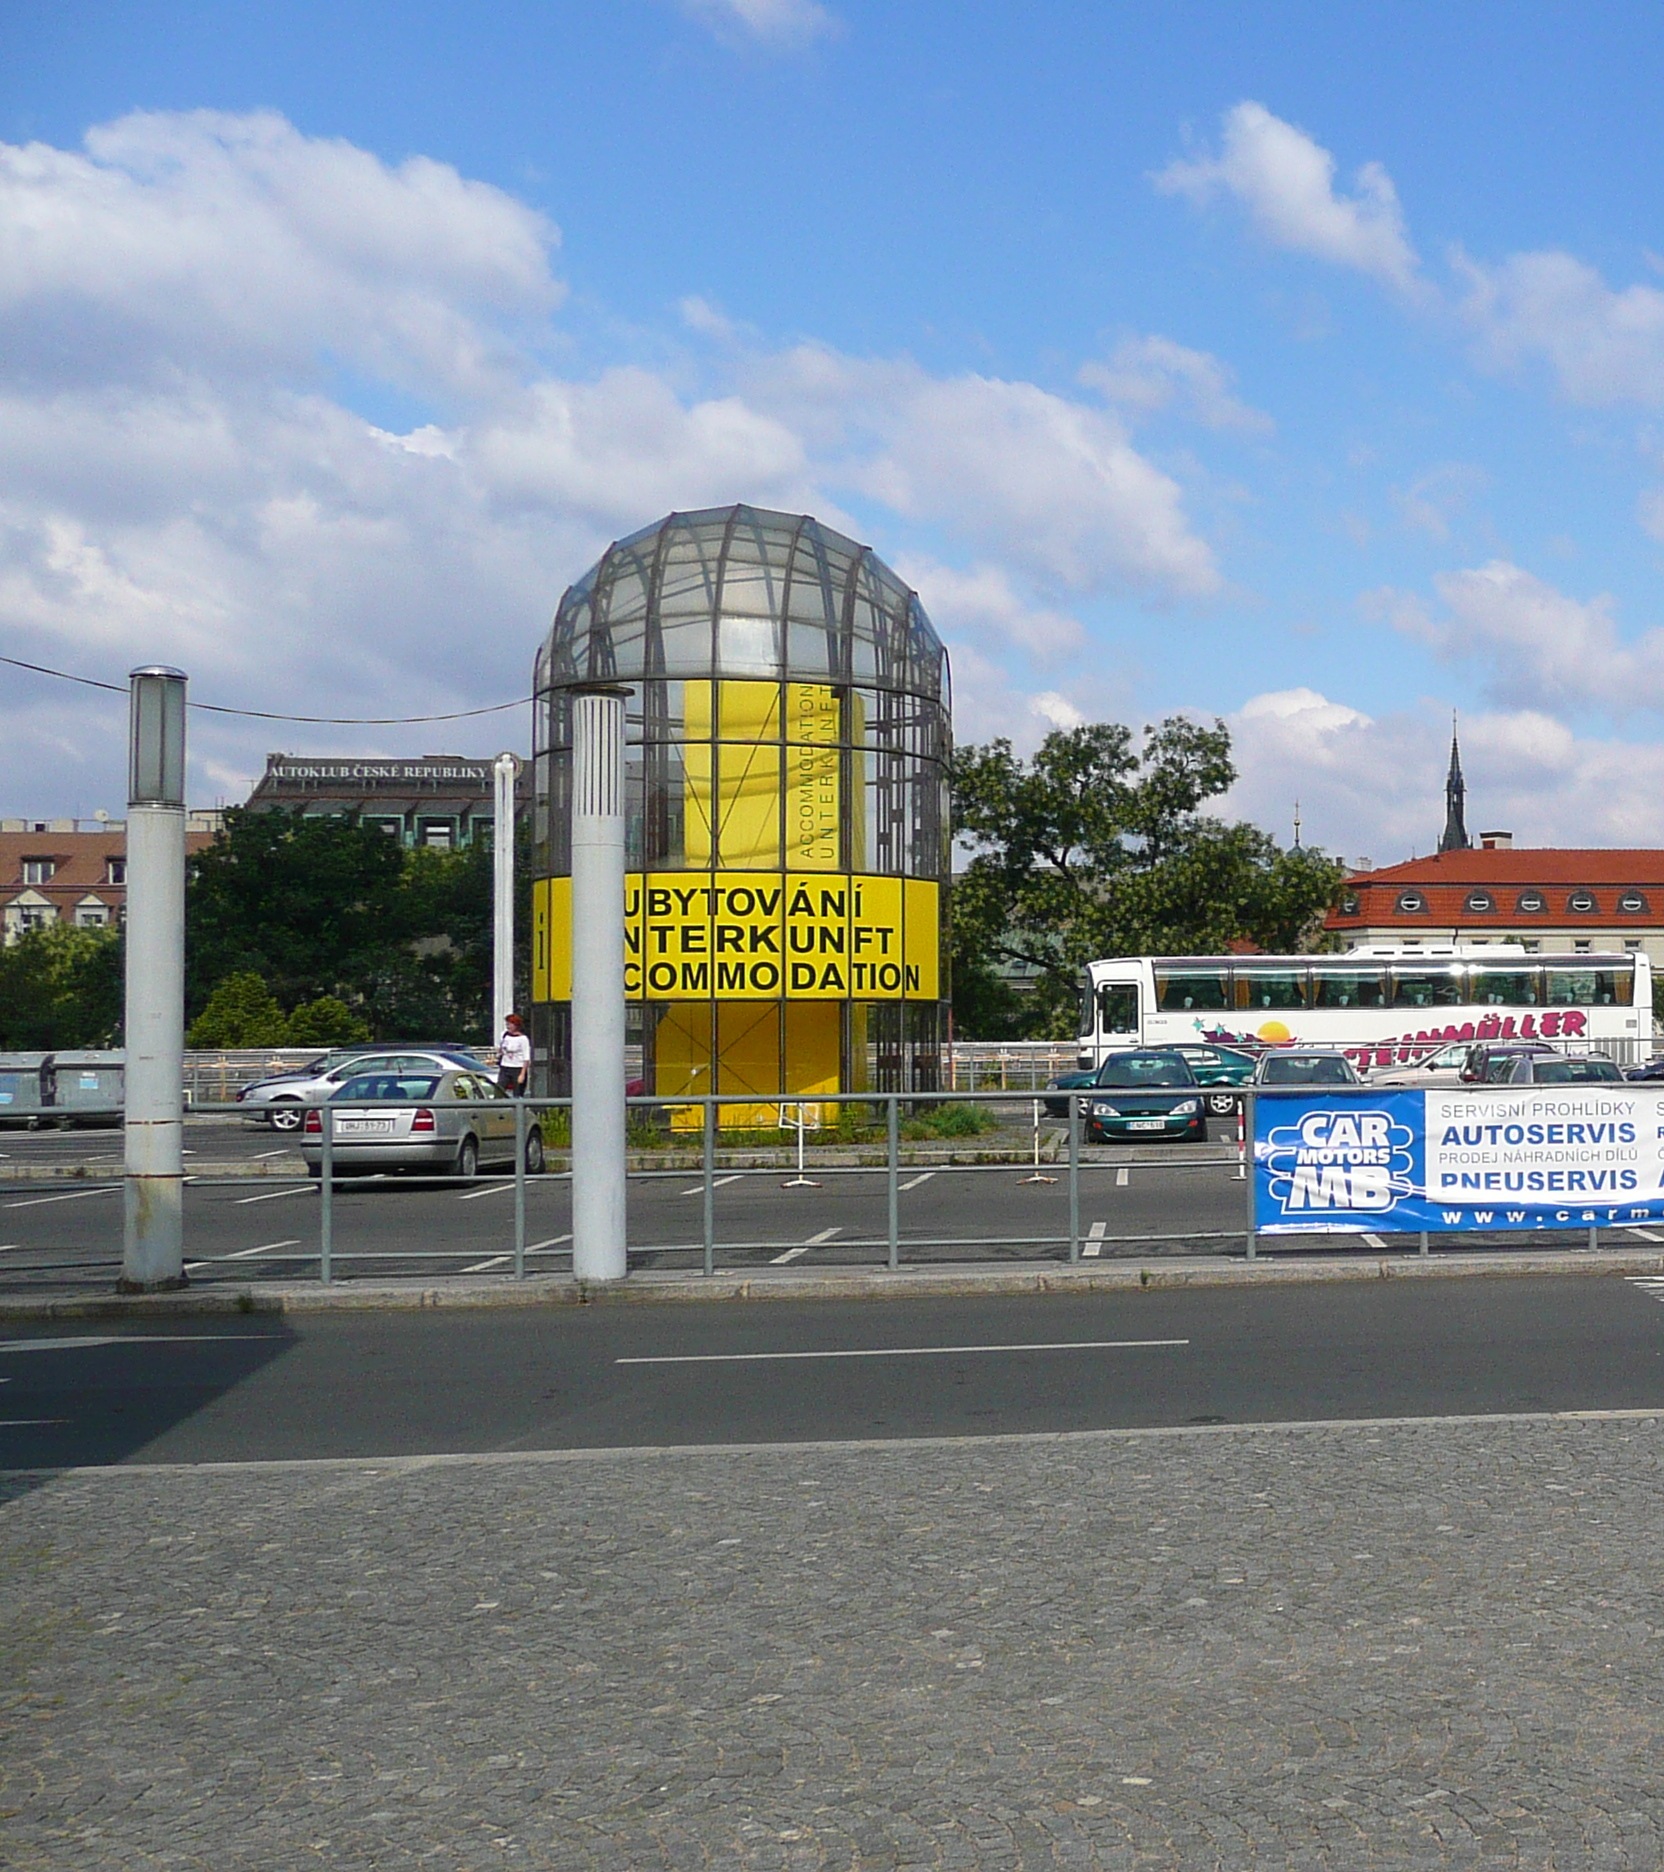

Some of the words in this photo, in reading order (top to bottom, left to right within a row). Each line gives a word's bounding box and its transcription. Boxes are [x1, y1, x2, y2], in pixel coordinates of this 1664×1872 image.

[268, 766, 350, 778] AUTOKLUB
[352, 763, 400, 778] ČESKÉ
[404, 766, 488, 779] REPUBLIKY
[800, 685, 814, 859] ACCOMMODATION
[819, 686, 835, 859] UNTERKUNFT
[623, 883, 863, 917] UBYTOVÁNÍ
[623, 925, 894, 954] NTERKUNFT
[623, 962, 920, 991] COMMODATION
[1343, 1011, 1587, 1074] TEINMÜLLER
[1441, 1100, 1526, 1118] SERVISNÍ
[1532, 1099, 1636, 1117] PROHLÍDKY
[1302, 1116, 1390, 1147] CAR
[1441, 1122, 1636, 1146] AUTOSERVIS
[1296, 1148, 1390, 1165] MOTORS
[1438, 1152, 1498, 1164] PRODEJ
[1503, 1148, 1601, 1163] NÁHRADNÍCH
[1605, 1147, 1638, 1161] DÍLŮ
[1288, 1166, 1391, 1208] MB
[1440, 1169, 1638, 1191] PNEUSERVIS
